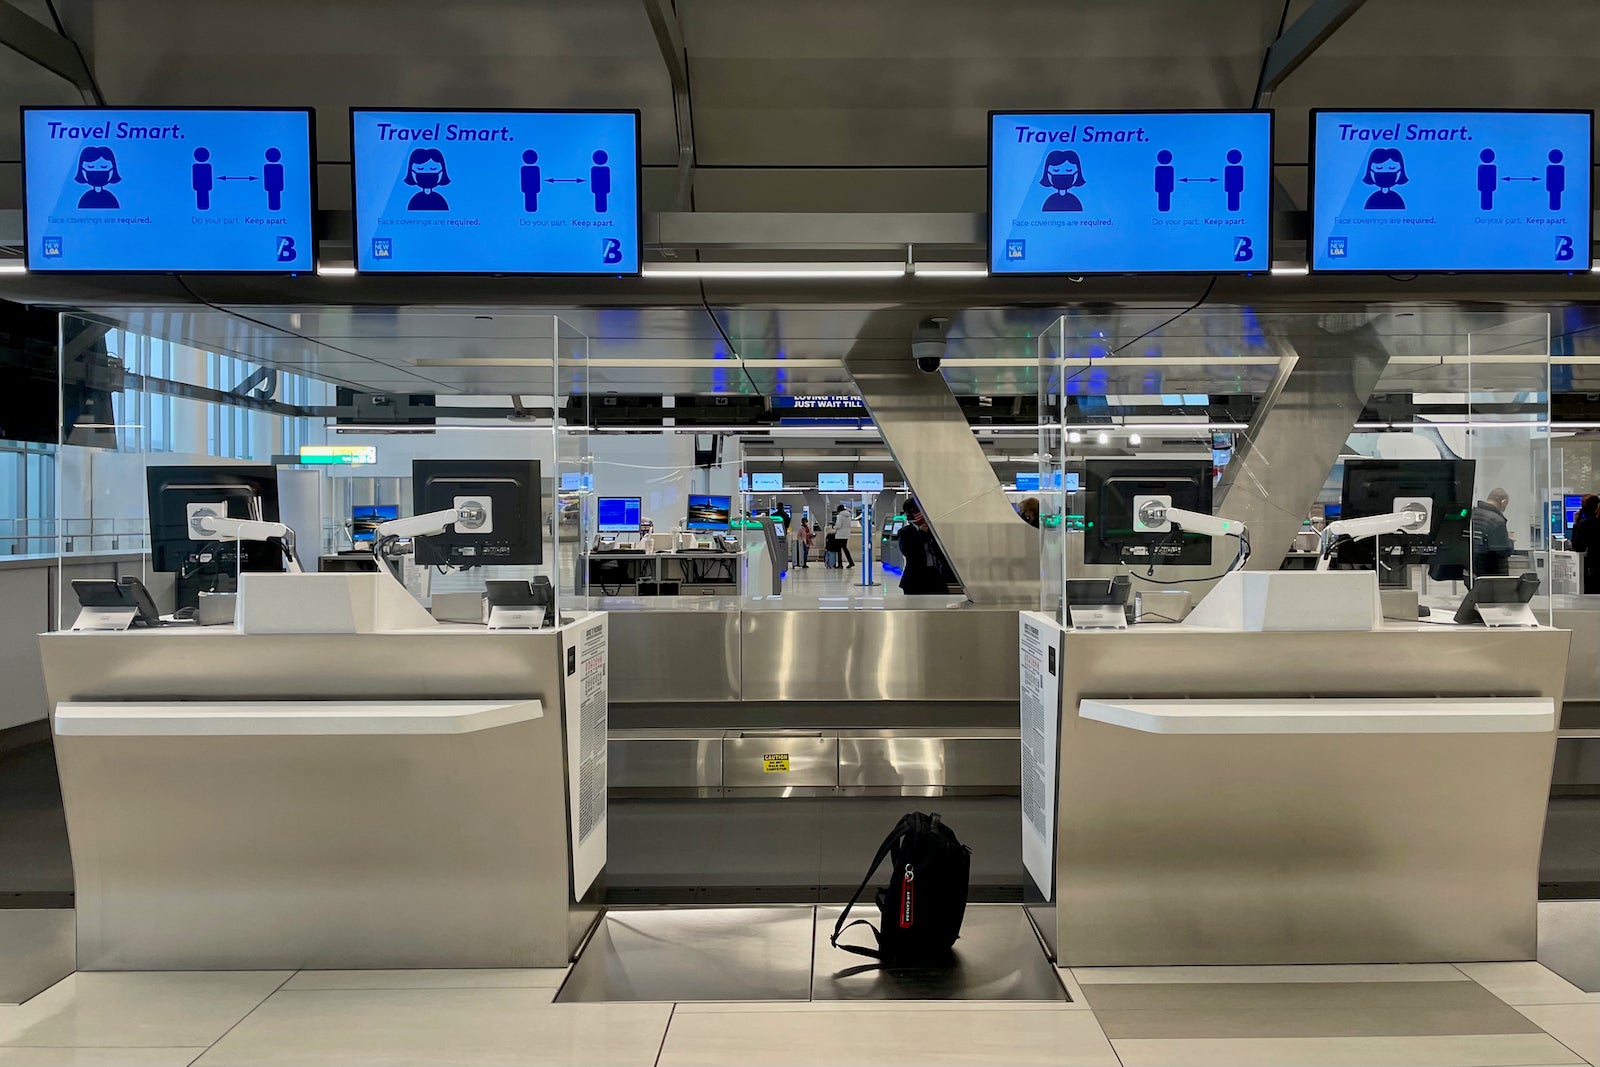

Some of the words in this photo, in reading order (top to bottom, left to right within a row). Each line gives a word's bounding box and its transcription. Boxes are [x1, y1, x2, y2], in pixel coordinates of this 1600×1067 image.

[48, 121, 111, 139] Travel
[116, 122, 185, 139] Smart.
[377, 123, 440, 141] Travel
[445, 124, 514, 142] Smart.
[1015, 125, 1077, 143] Travel
[1082, 126, 1150, 143] Smart.
[1338, 123, 1401, 141] Travel
[1405, 124, 1473, 141] Smart.
[48, 216, 64, 224] Face
[66, 217, 102, 226] coverings
[117, 216, 152, 225] required.
[192, 216, 203, 224] Do
[205, 218, 221, 226] your
[245, 217, 265, 226] Keep
[396, 219, 431, 227] coverings
[446, 218, 480, 227] required.
[520, 218, 531, 226] Do
[533, 219, 549, 227] your
[572, 219, 591, 228] Keep
[1012, 219, 1029, 227] Face
[1030, 219, 1065, 228] coverings
[1080, 218, 1114, 228] required.
[1152, 218, 1164, 226] Do
[1165, 219, 1181, 228] your
[1204, 218, 1223, 227] Keep
[1334, 217, 1351, 225] Face
[1353, 217, 1387, 226] coverings
[1402, 217, 1436, 226] required.
[1474, 216, 1486, 225] Do
[1488, 217, 1503, 226] your
[1526, 217, 1545, 226] Keep
